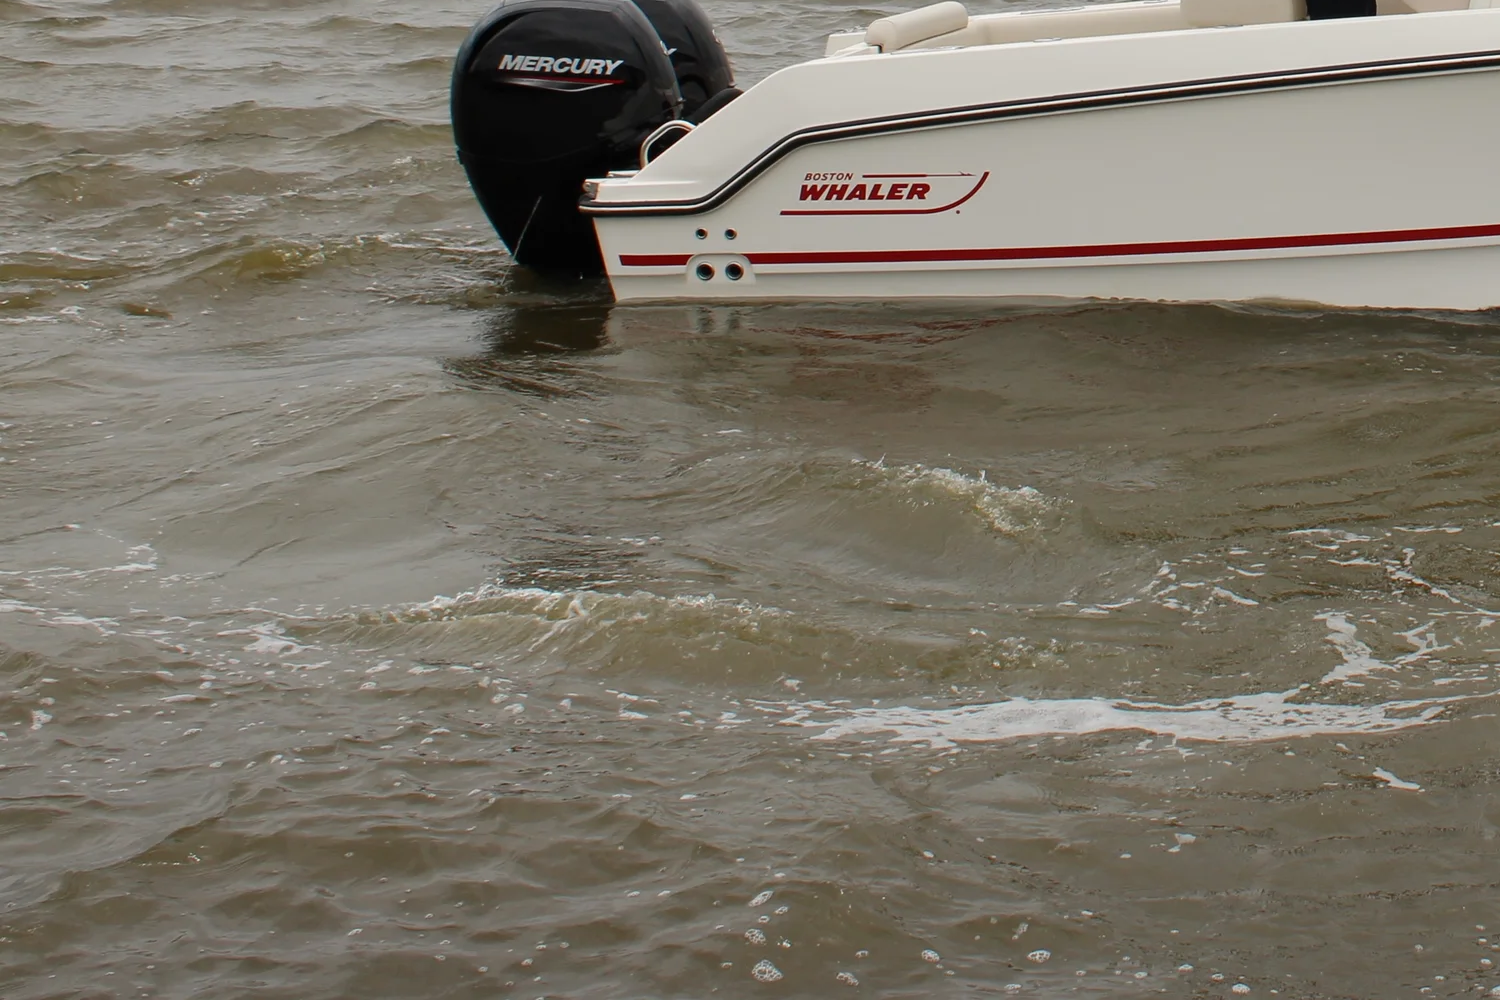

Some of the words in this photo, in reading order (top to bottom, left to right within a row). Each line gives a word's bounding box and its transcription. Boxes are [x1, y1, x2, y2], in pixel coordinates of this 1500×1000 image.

[498, 54, 624, 75] MERCURY
[804, 172, 854, 181] BOSTON
[799, 183, 931, 201] WHALER
